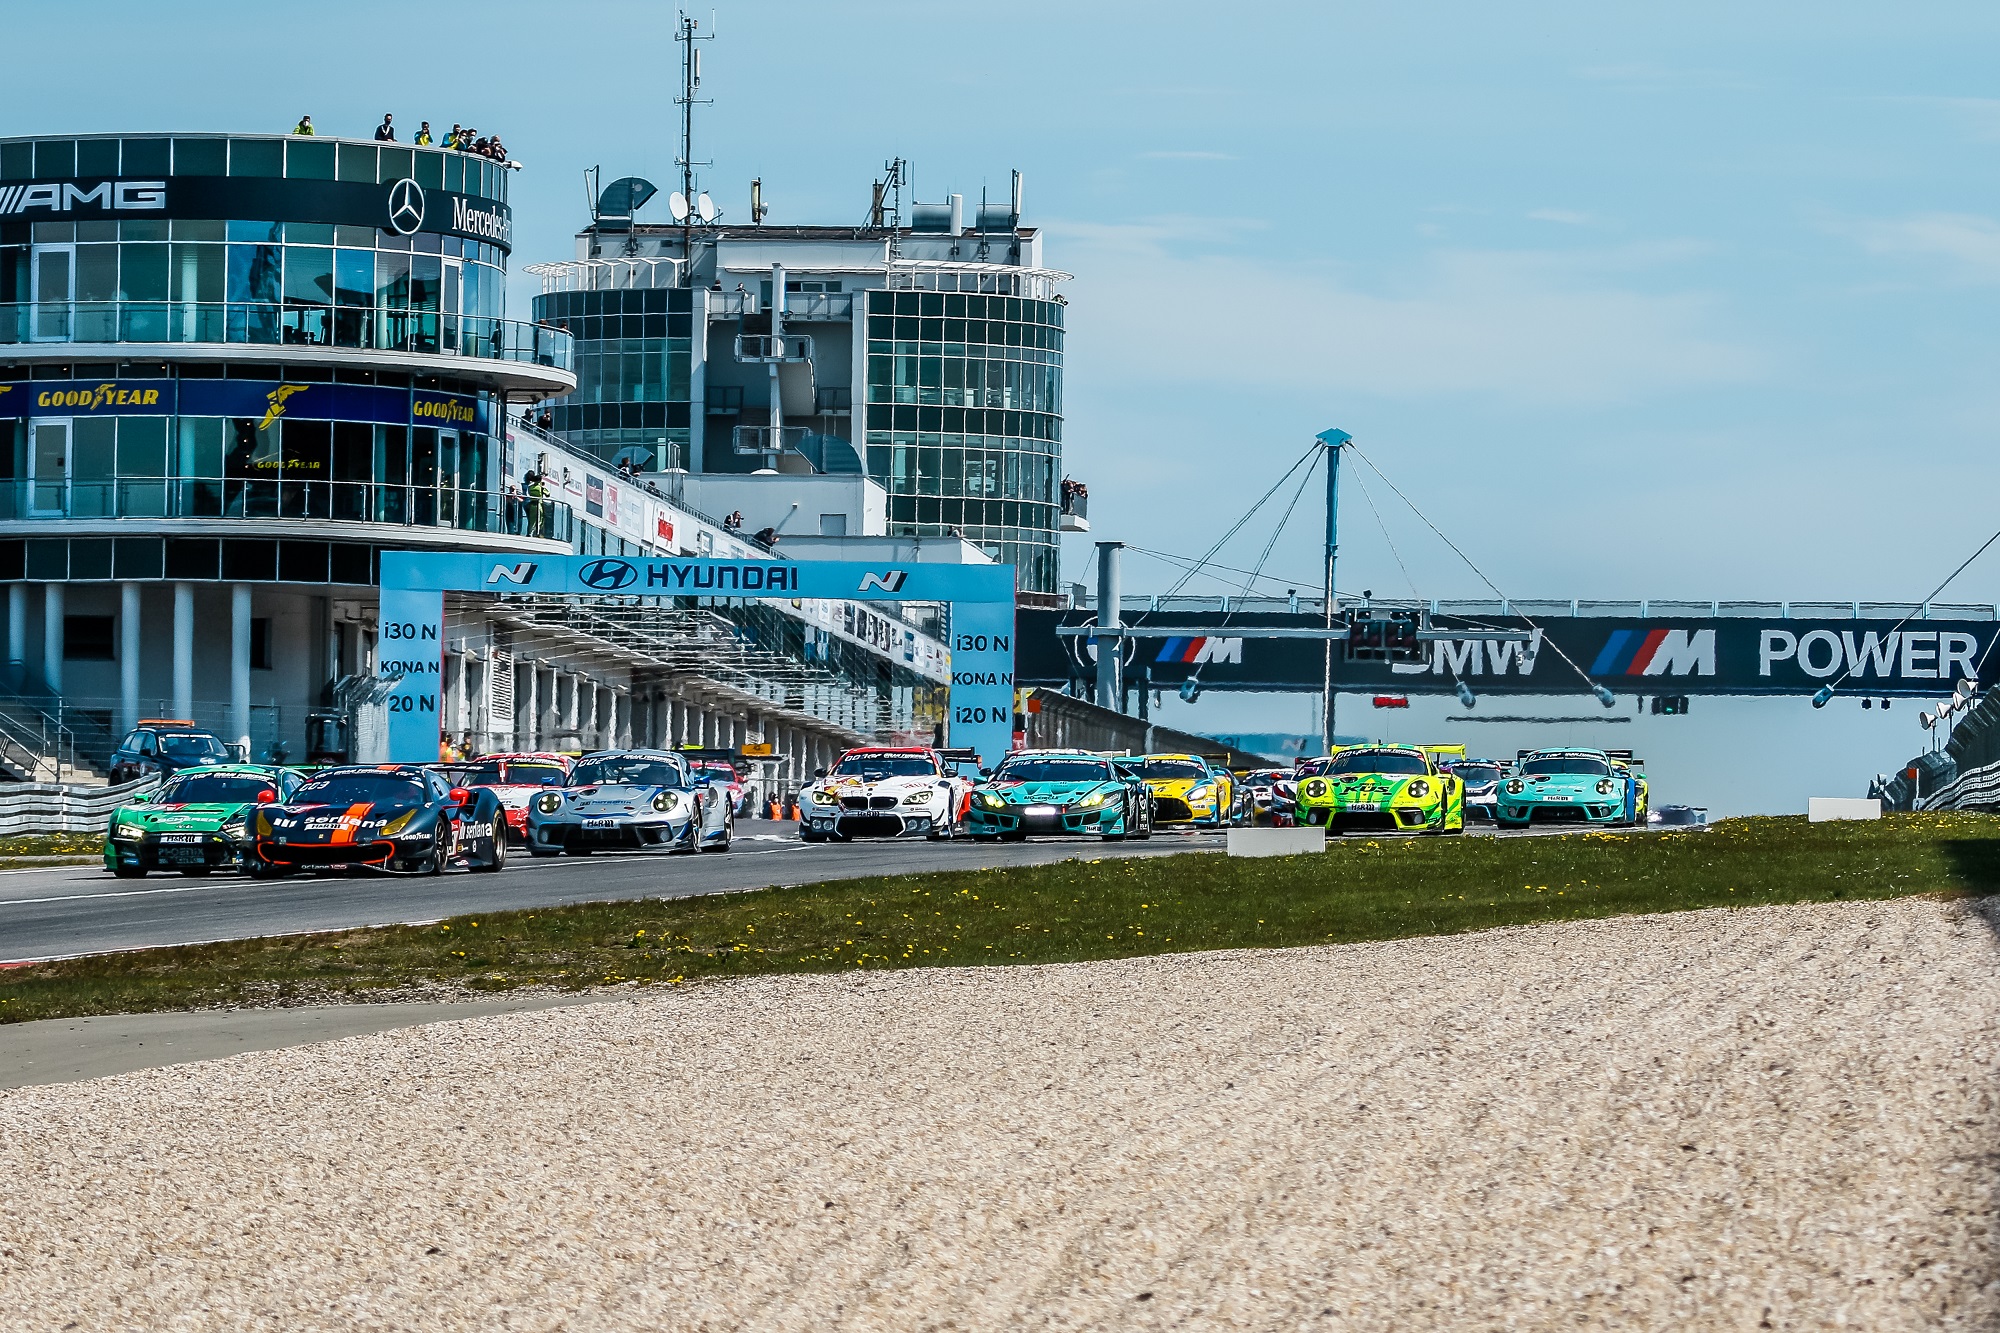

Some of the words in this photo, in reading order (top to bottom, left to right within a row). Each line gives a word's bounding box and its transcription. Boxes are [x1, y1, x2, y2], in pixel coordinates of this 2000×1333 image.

[15, 181, 166, 213] AMG
[38, 387, 159, 408] GOODYEAR
[413, 400, 474, 422] GOODYEAR
[648, 564, 798, 591] HYUNDAI
[384, 622, 415, 640] i30
[421, 624, 436, 640] N
[956, 634, 988, 651] i30
[993, 635, 1009, 652] N
[1392, 627, 1544, 675] MW
[1759, 629, 1978, 679] POWER
[380, 660, 424, 674] KONA
[428, 661, 439, 673] N
[952, 672, 997, 686] KONA
[1001, 672, 1013, 686] N
[389, 694, 413, 712] 20
[419, 694, 435, 712] N
[956, 706, 987, 724] i20
[992, 706, 1007, 723] N
